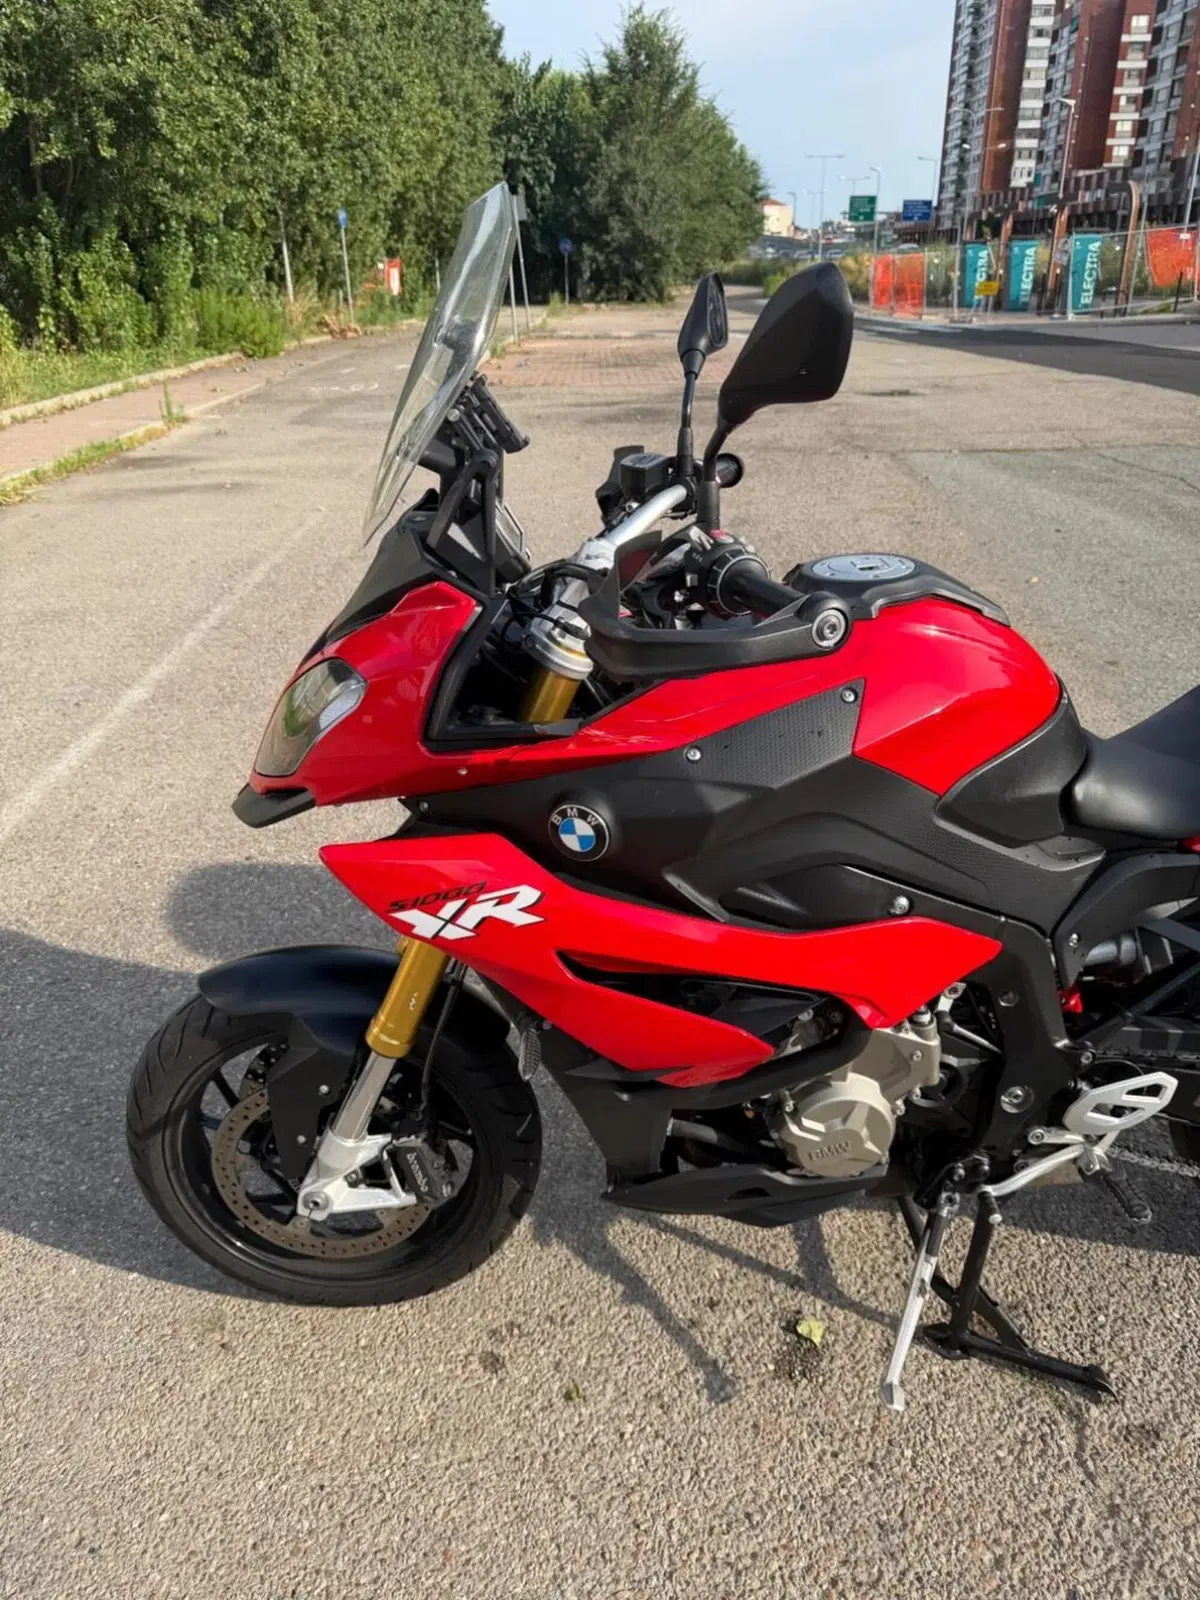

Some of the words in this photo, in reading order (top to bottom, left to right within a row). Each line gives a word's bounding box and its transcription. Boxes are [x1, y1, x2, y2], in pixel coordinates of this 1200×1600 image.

[1080, 240, 1101, 304] ELECTRA
[551, 807, 600, 827] BMW
[387, 880, 488, 910] S1000
[387, 884, 546, 941] XR
[807, 1140, 852, 1162] BMW
[405, 1151, 430, 1193] brembo
